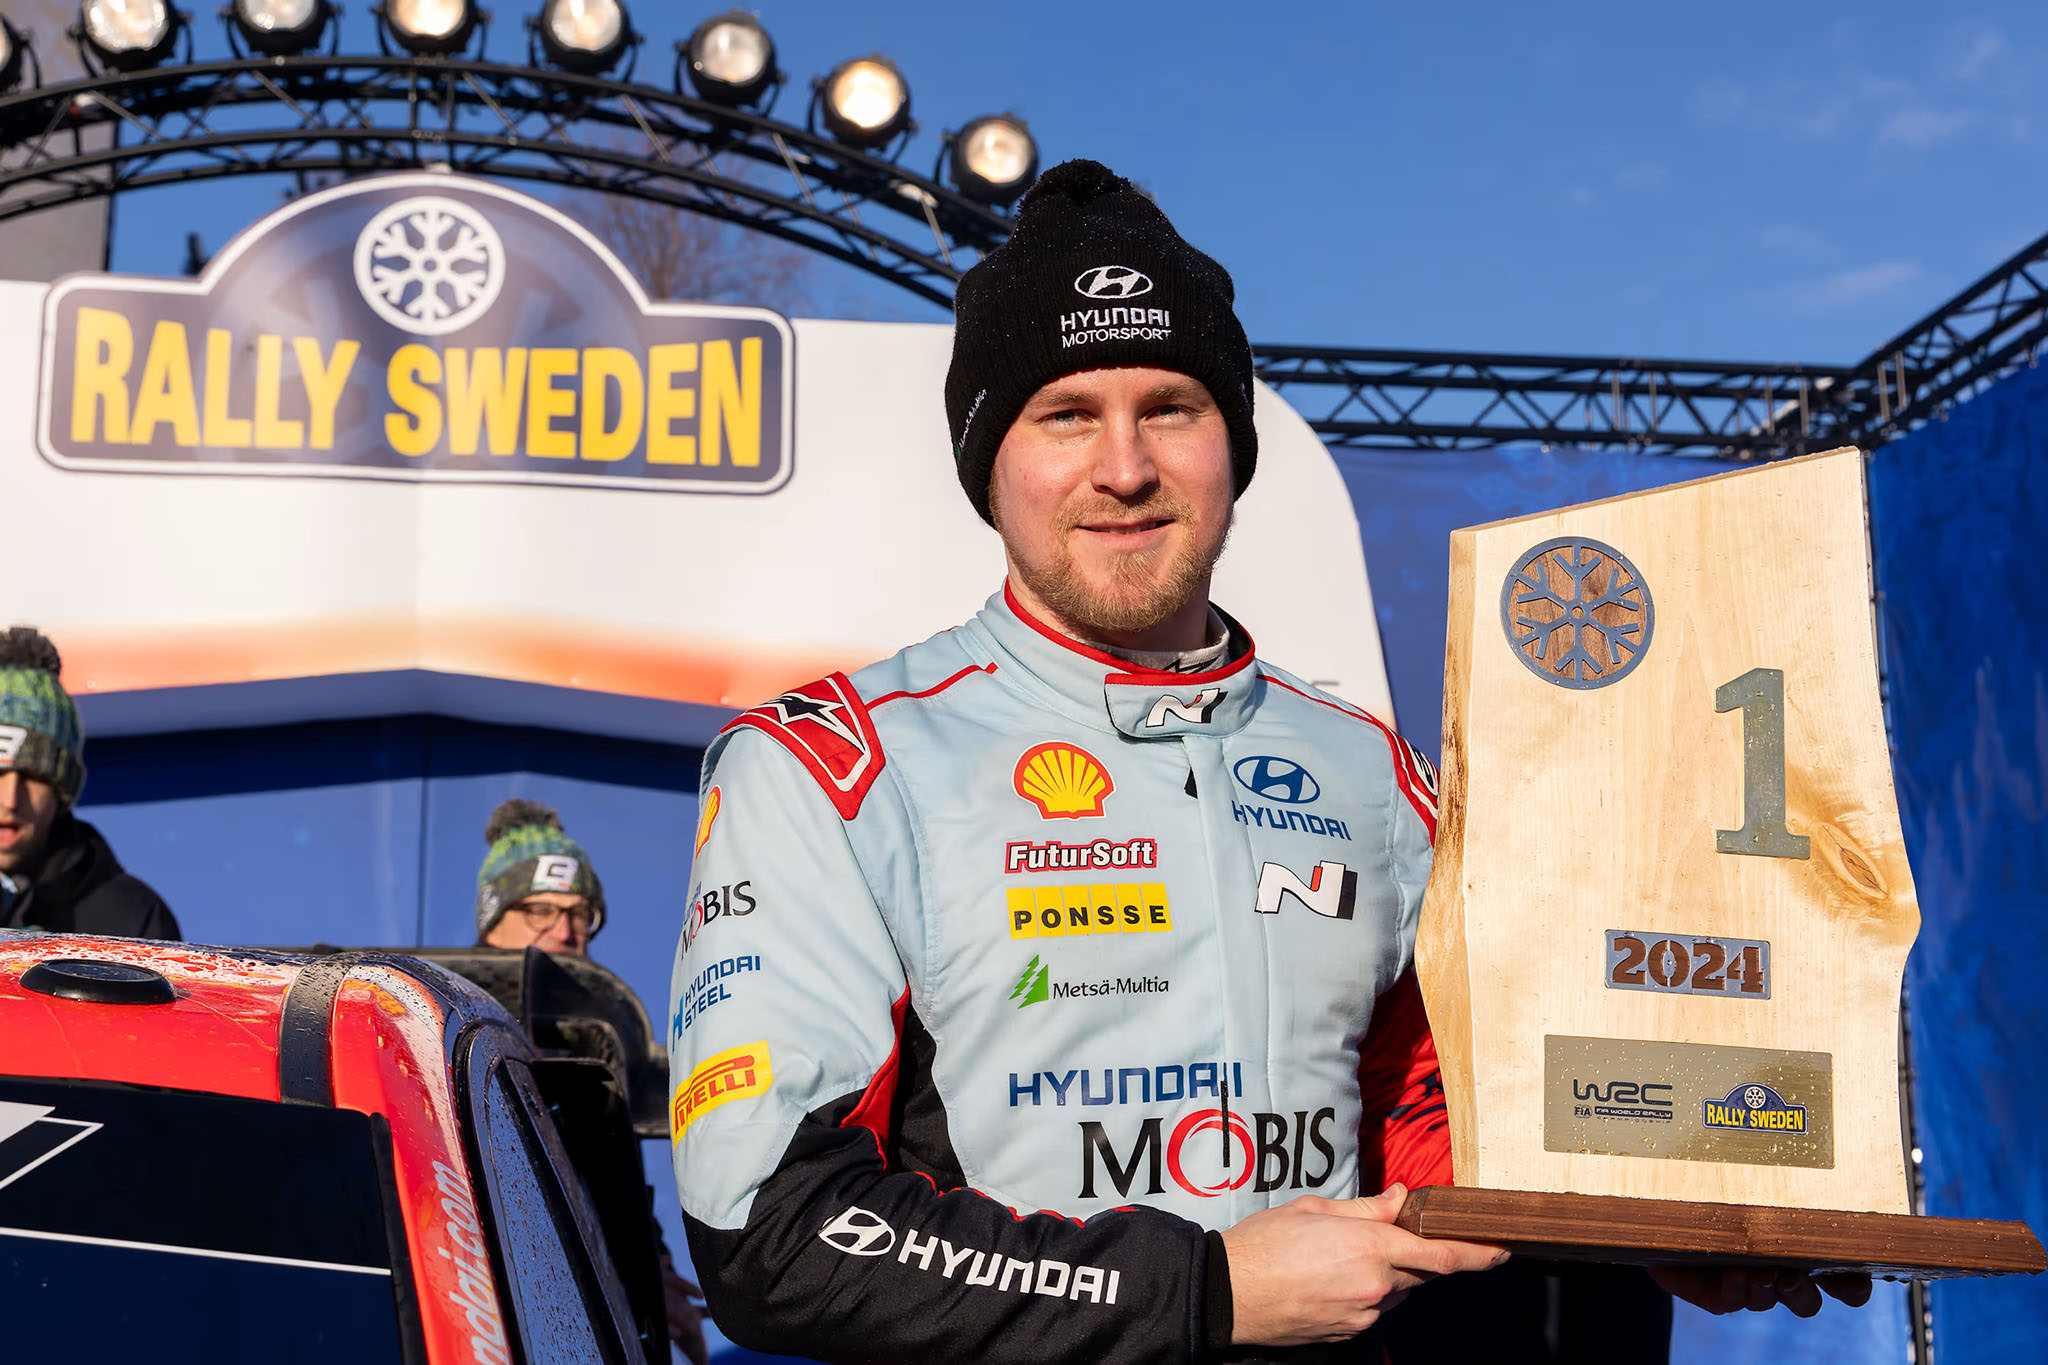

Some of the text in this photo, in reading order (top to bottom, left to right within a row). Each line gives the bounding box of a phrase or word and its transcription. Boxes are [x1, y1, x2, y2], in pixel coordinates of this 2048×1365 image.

[1060, 307, 1171, 332] HYUNDAI
[1061, 327, 1172, 349] MOTORSPORT
[70, 306, 763, 468] RALLY SWEDEN
[1714, 668, 1811, 860] 1
[1231, 800, 1353, 841] HYUNDAI
[1008, 840, 1156, 871] FuturSoft
[681, 880, 756, 960] MOBIS
[1013, 905, 1167, 931] PONSSE
[684, 955, 761, 1008] HYUNDAI
[1052, 976, 1170, 1000] Metsä-Multia
[1611, 936, 1765, 994] 2024
[684, 983, 732, 1030] STEEL
[674, 1054, 757, 1135] PIRELLI
[1008, 1061, 1243, 1107] HYUNDAI
[1573, 1078, 1674, 1107] WRC
[1706, 1103, 1804, 1131] RALLY SWEDEN
[1076, 1106, 1336, 1199] MOBIS
[897, 1229, 1121, 1305] HYUNDAI
